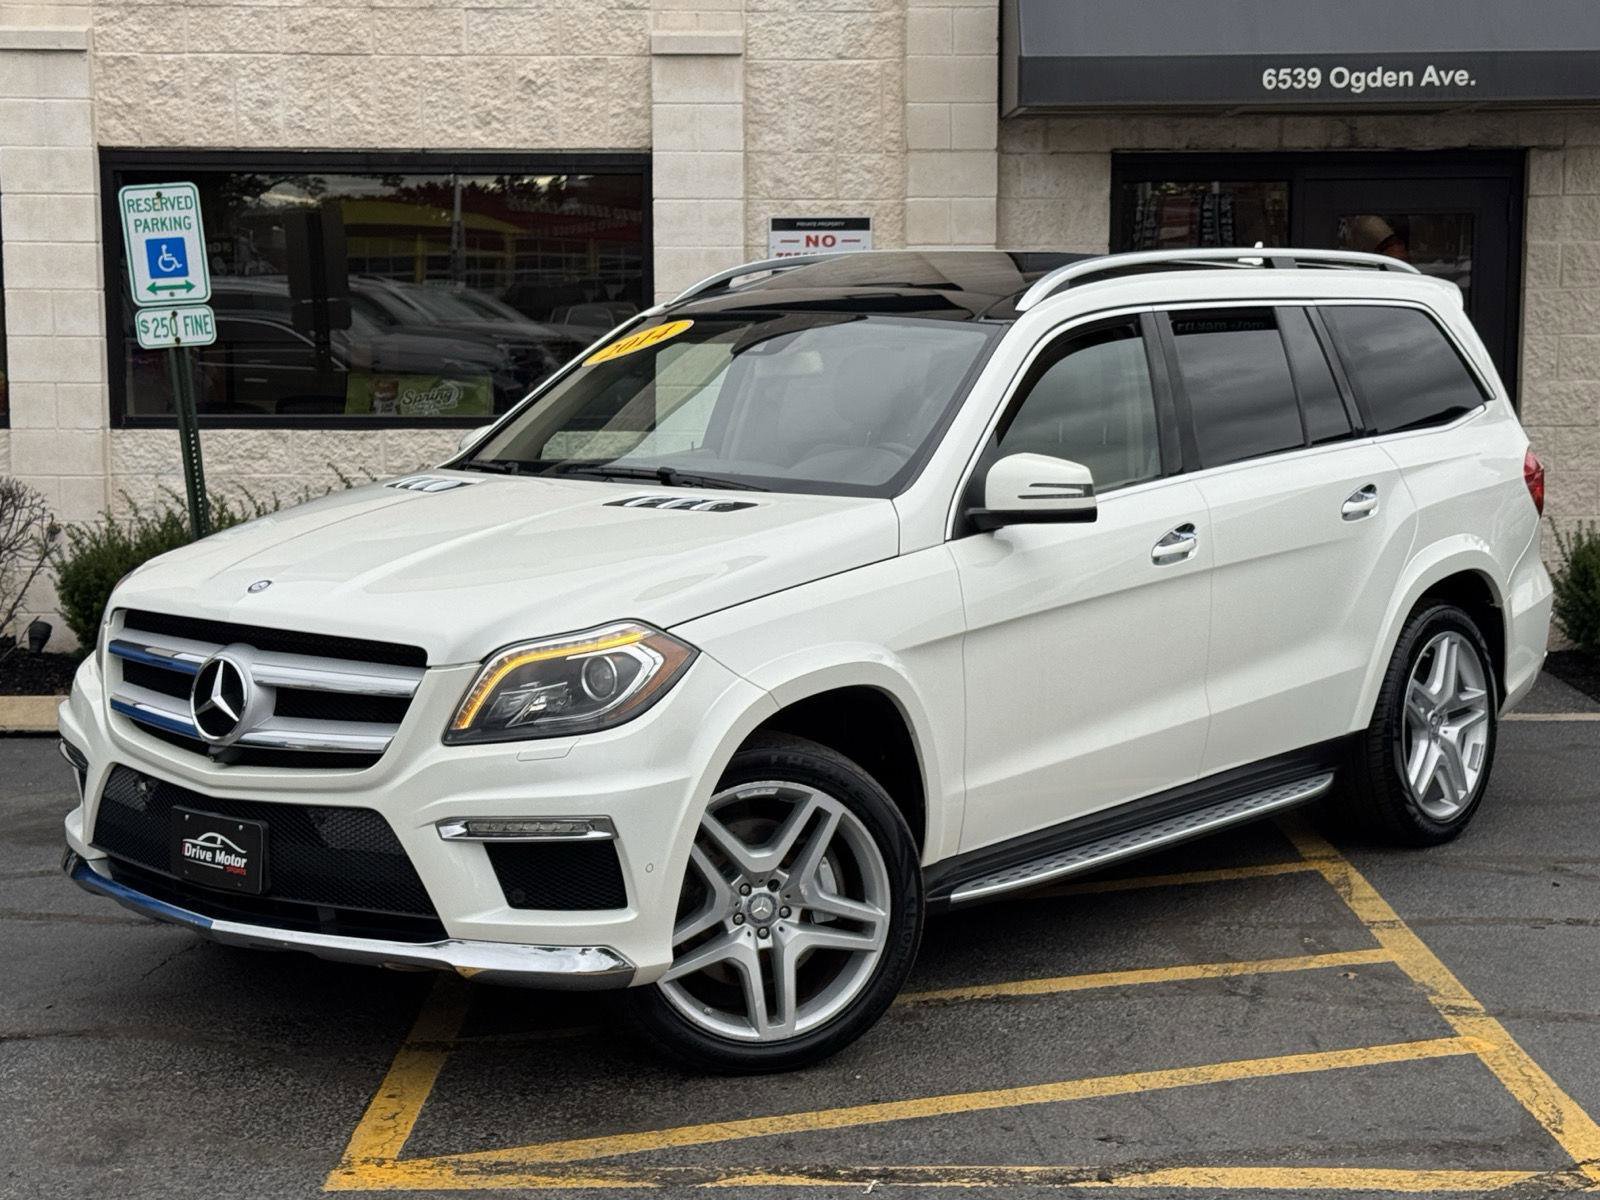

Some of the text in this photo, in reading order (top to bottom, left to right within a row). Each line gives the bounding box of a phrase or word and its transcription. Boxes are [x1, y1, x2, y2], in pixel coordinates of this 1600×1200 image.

[1262, 65, 1476, 93] 6539 Ogden Ave.
[127, 195, 193, 213] RESERVED
[134, 215, 192, 233] PARKING
[805, 235, 836, 248] NO
[140, 314, 212, 339] $250 FINE
[402, 389, 454, 405] Spring
[184, 842, 248, 868] Drive Motor
